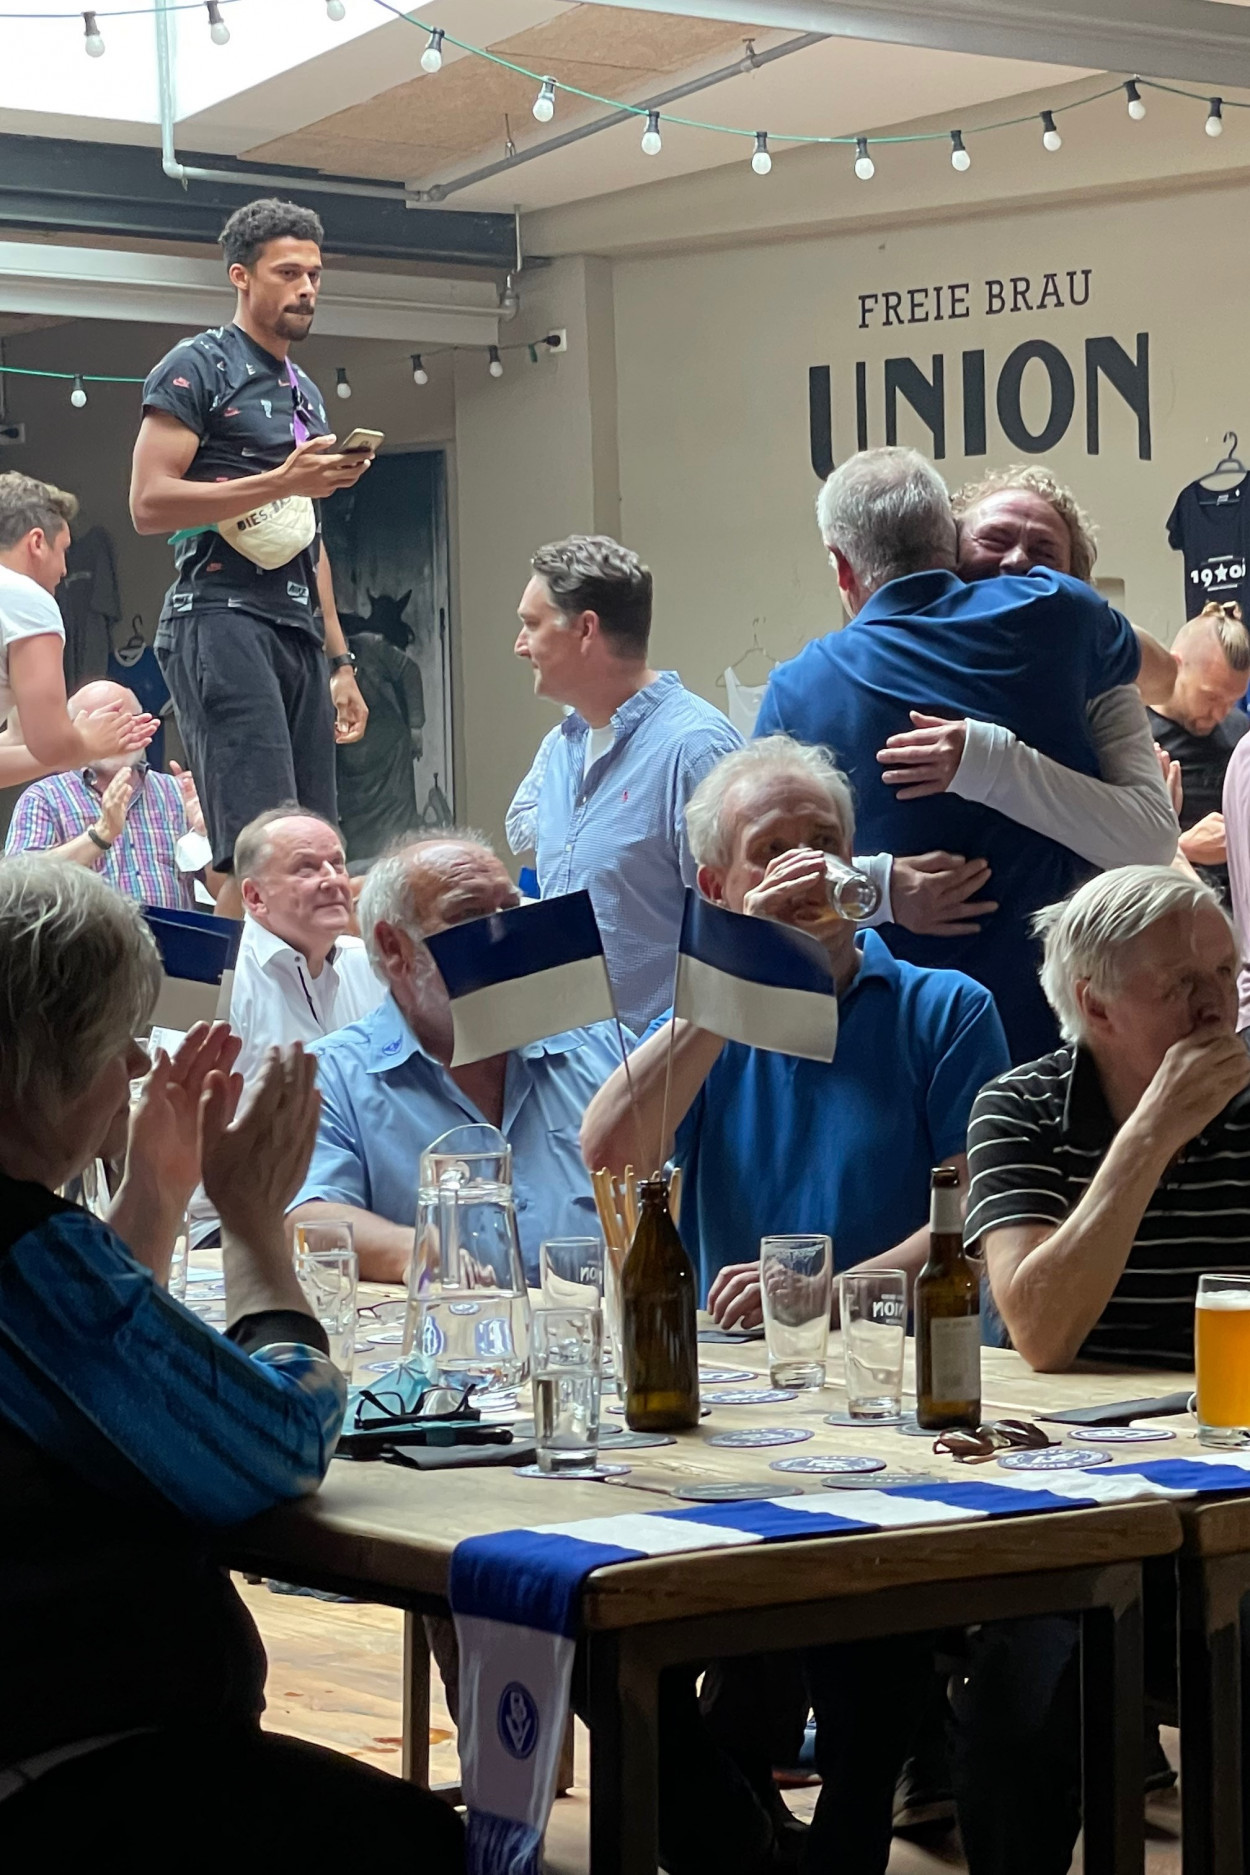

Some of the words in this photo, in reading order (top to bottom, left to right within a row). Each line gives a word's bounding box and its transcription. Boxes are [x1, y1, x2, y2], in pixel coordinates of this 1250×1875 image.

[858, 283, 970, 329] FREIE
[985, 269, 1092, 315] BRAU
[809, 332, 1152, 482] UNION
